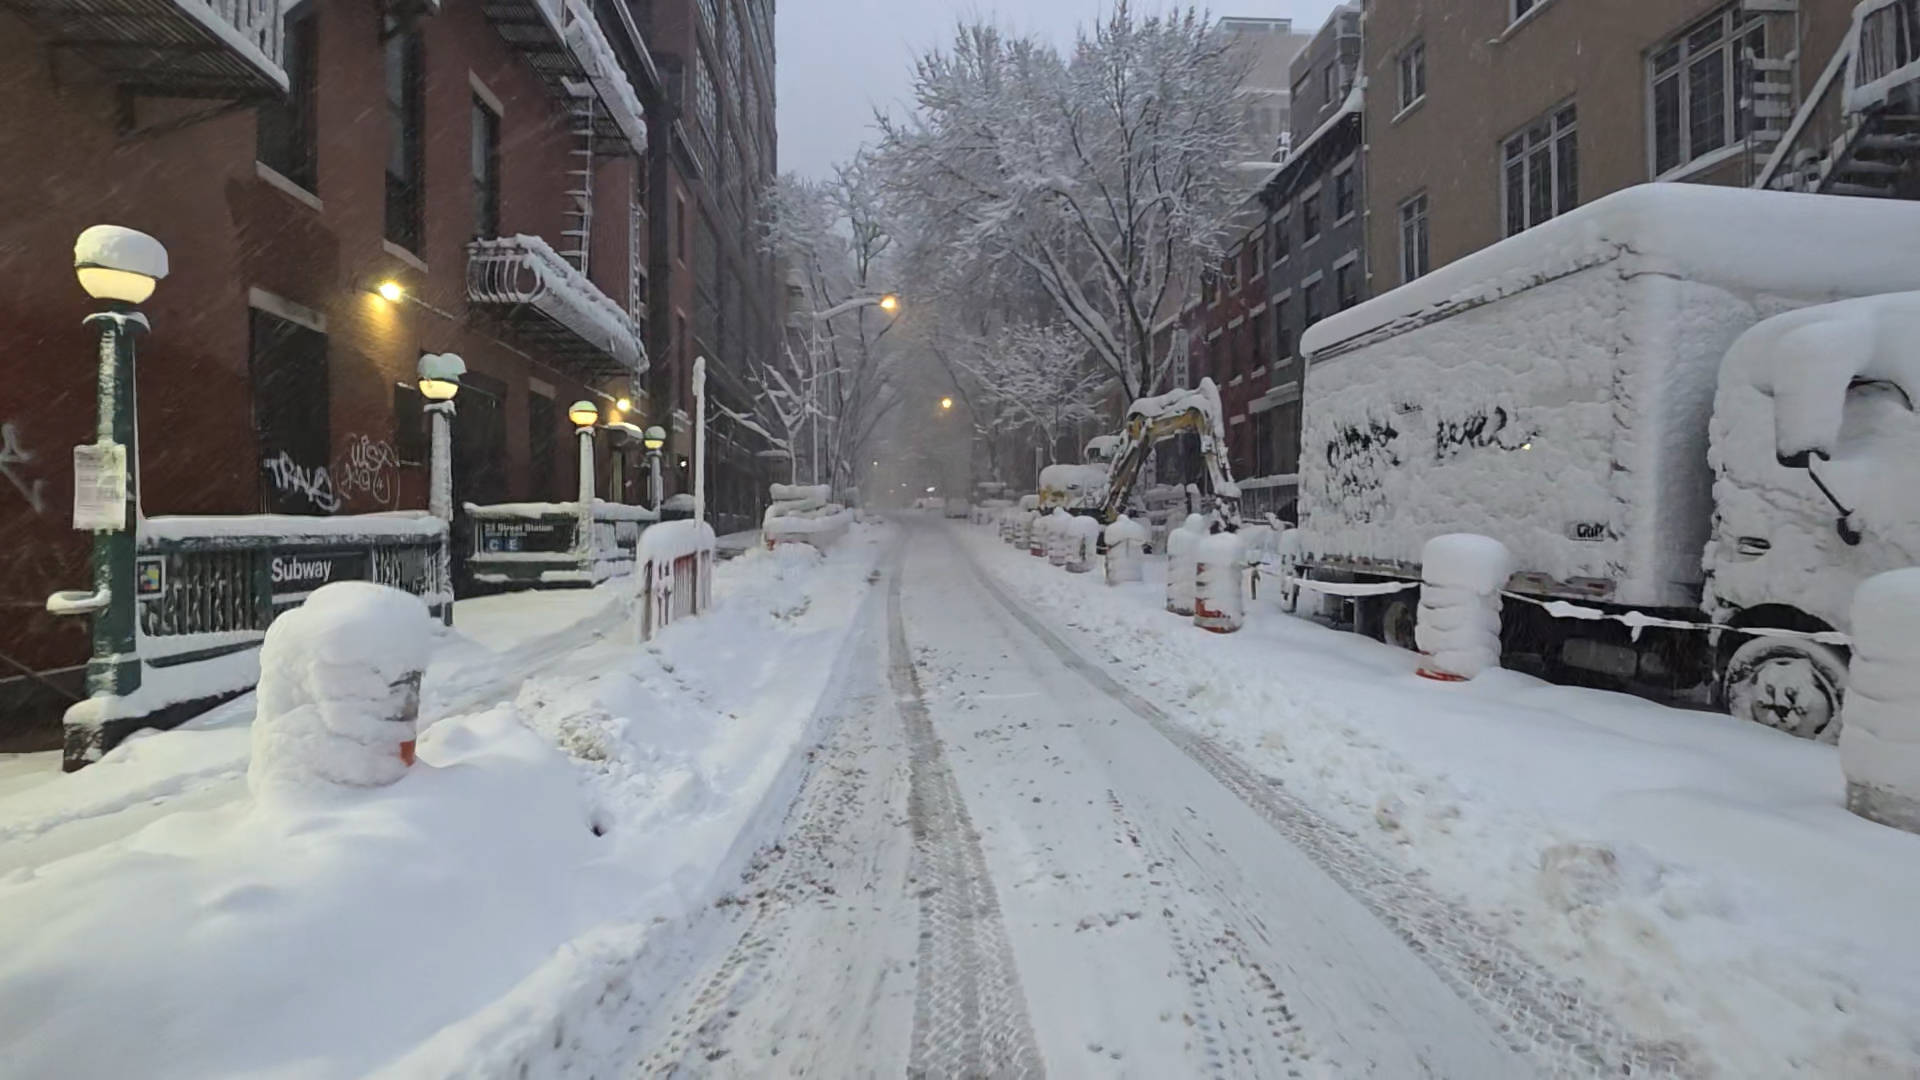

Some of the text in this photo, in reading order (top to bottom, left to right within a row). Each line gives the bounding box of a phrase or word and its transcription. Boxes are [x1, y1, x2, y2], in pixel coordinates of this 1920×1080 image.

[489, 538, 518, 551] C E
[271, 556, 332, 582] Subway
